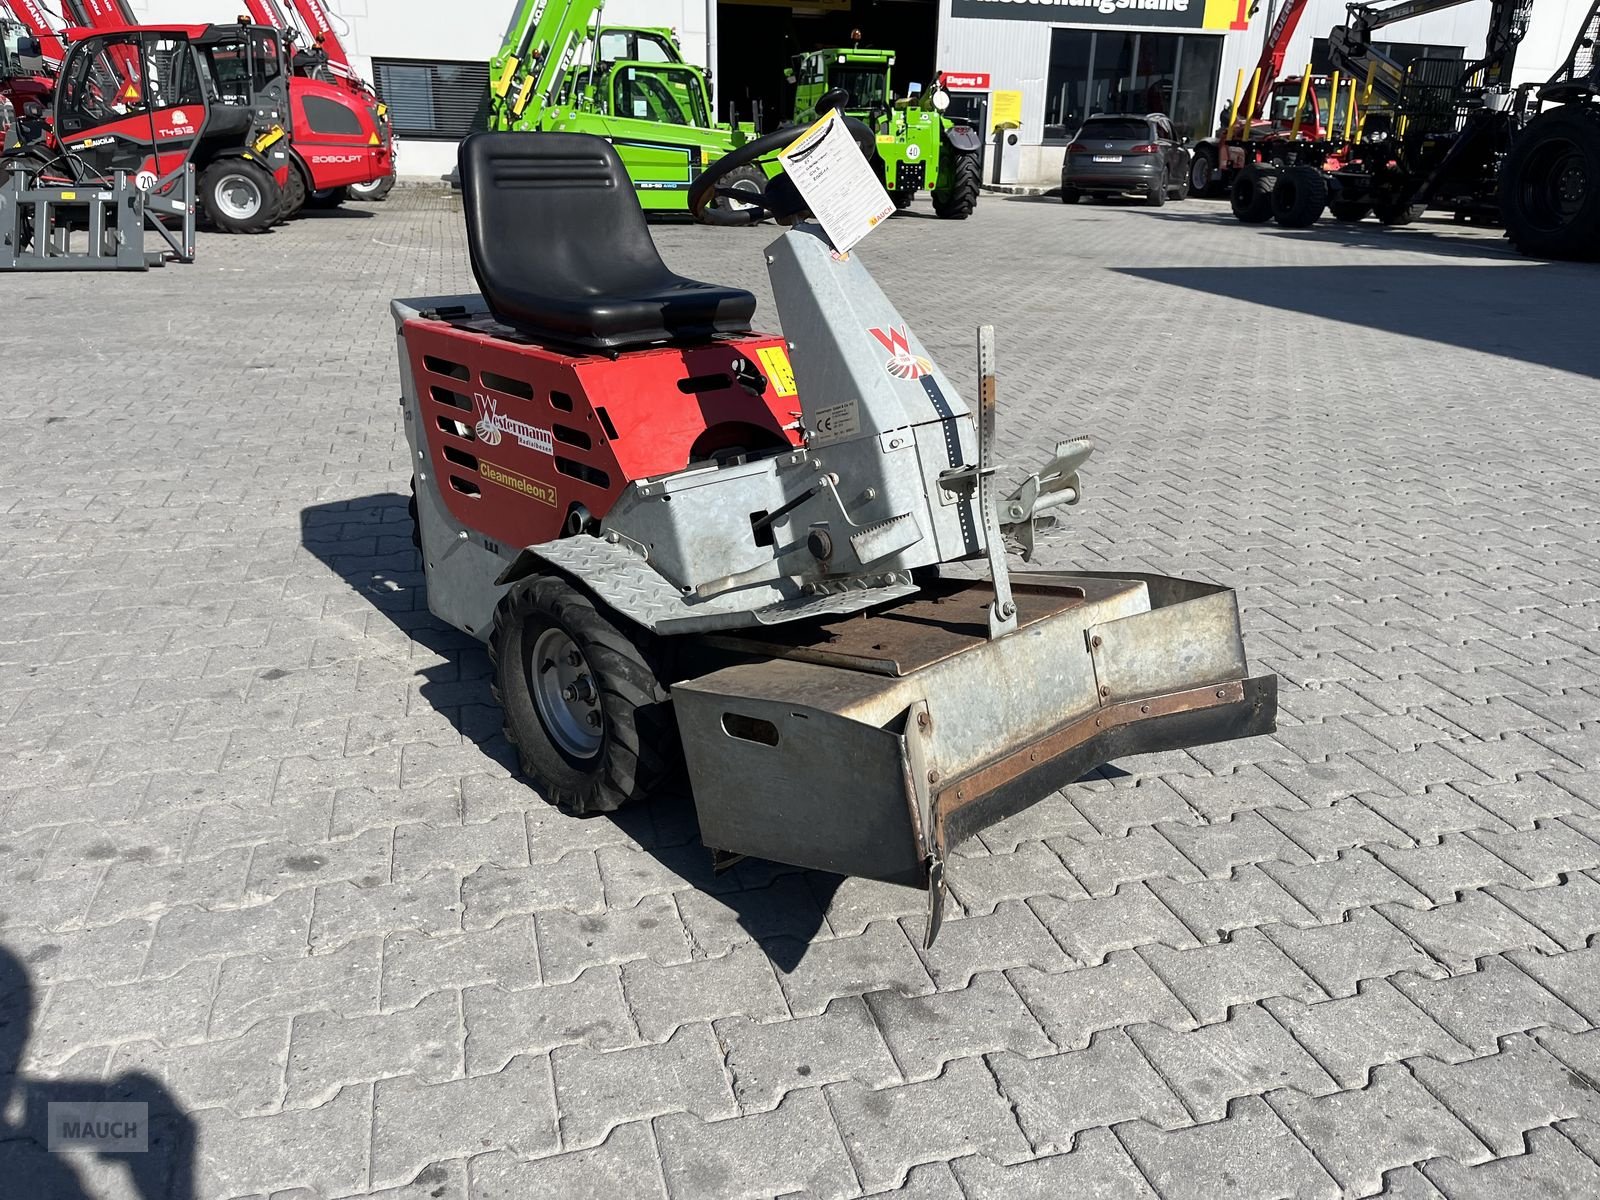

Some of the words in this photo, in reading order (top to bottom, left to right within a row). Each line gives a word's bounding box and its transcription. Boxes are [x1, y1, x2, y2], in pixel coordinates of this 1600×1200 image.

[1269, 0, 1294, 48] FEUER
[946, 76, 976, 86] Eingang
[159, 126, 195, 137] T4512
[908, 147, 918, 157] 40
[140, 175, 154, 189] 20
[870, 205, 893, 226] MAUCH
[474, 392, 552, 444] Westermann
[519, 438, 552, 453] Radialbesen
[480, 462, 547, 500] Cleanmeleon
[547, 488, 556, 504] 2
